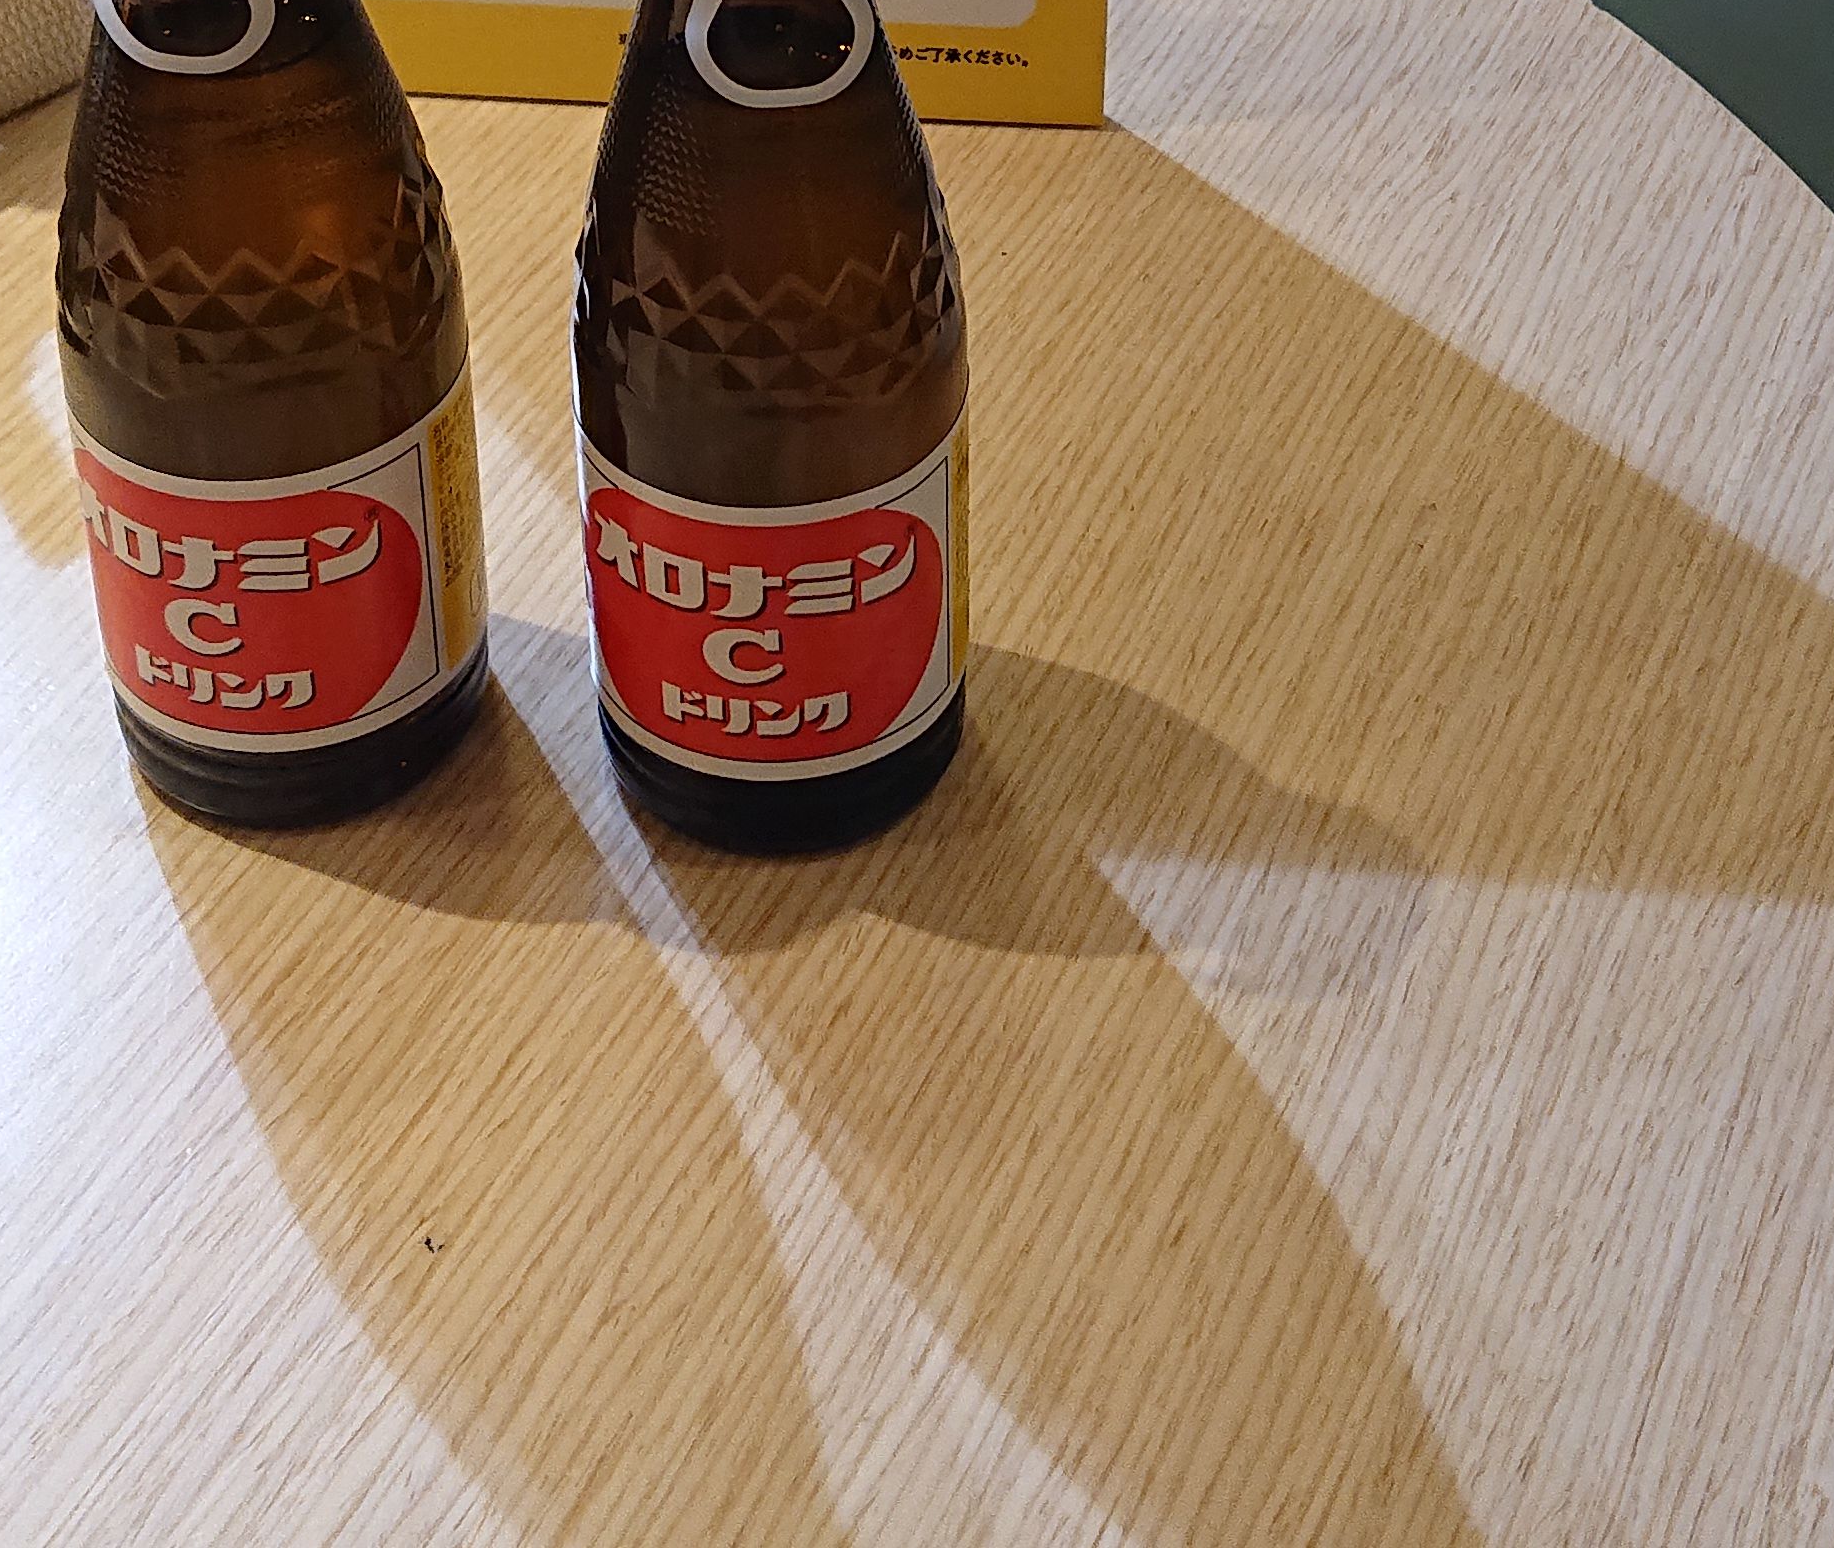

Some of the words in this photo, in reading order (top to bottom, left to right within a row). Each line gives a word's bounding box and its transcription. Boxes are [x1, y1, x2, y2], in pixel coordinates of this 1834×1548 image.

[593, 509, 917, 620] オロナミン
[165, 598, 243, 655] C
[135, 643, 316, 710] ドリンク
[702, 628, 785, 685] C
[661, 679, 851, 737] ドリンク
